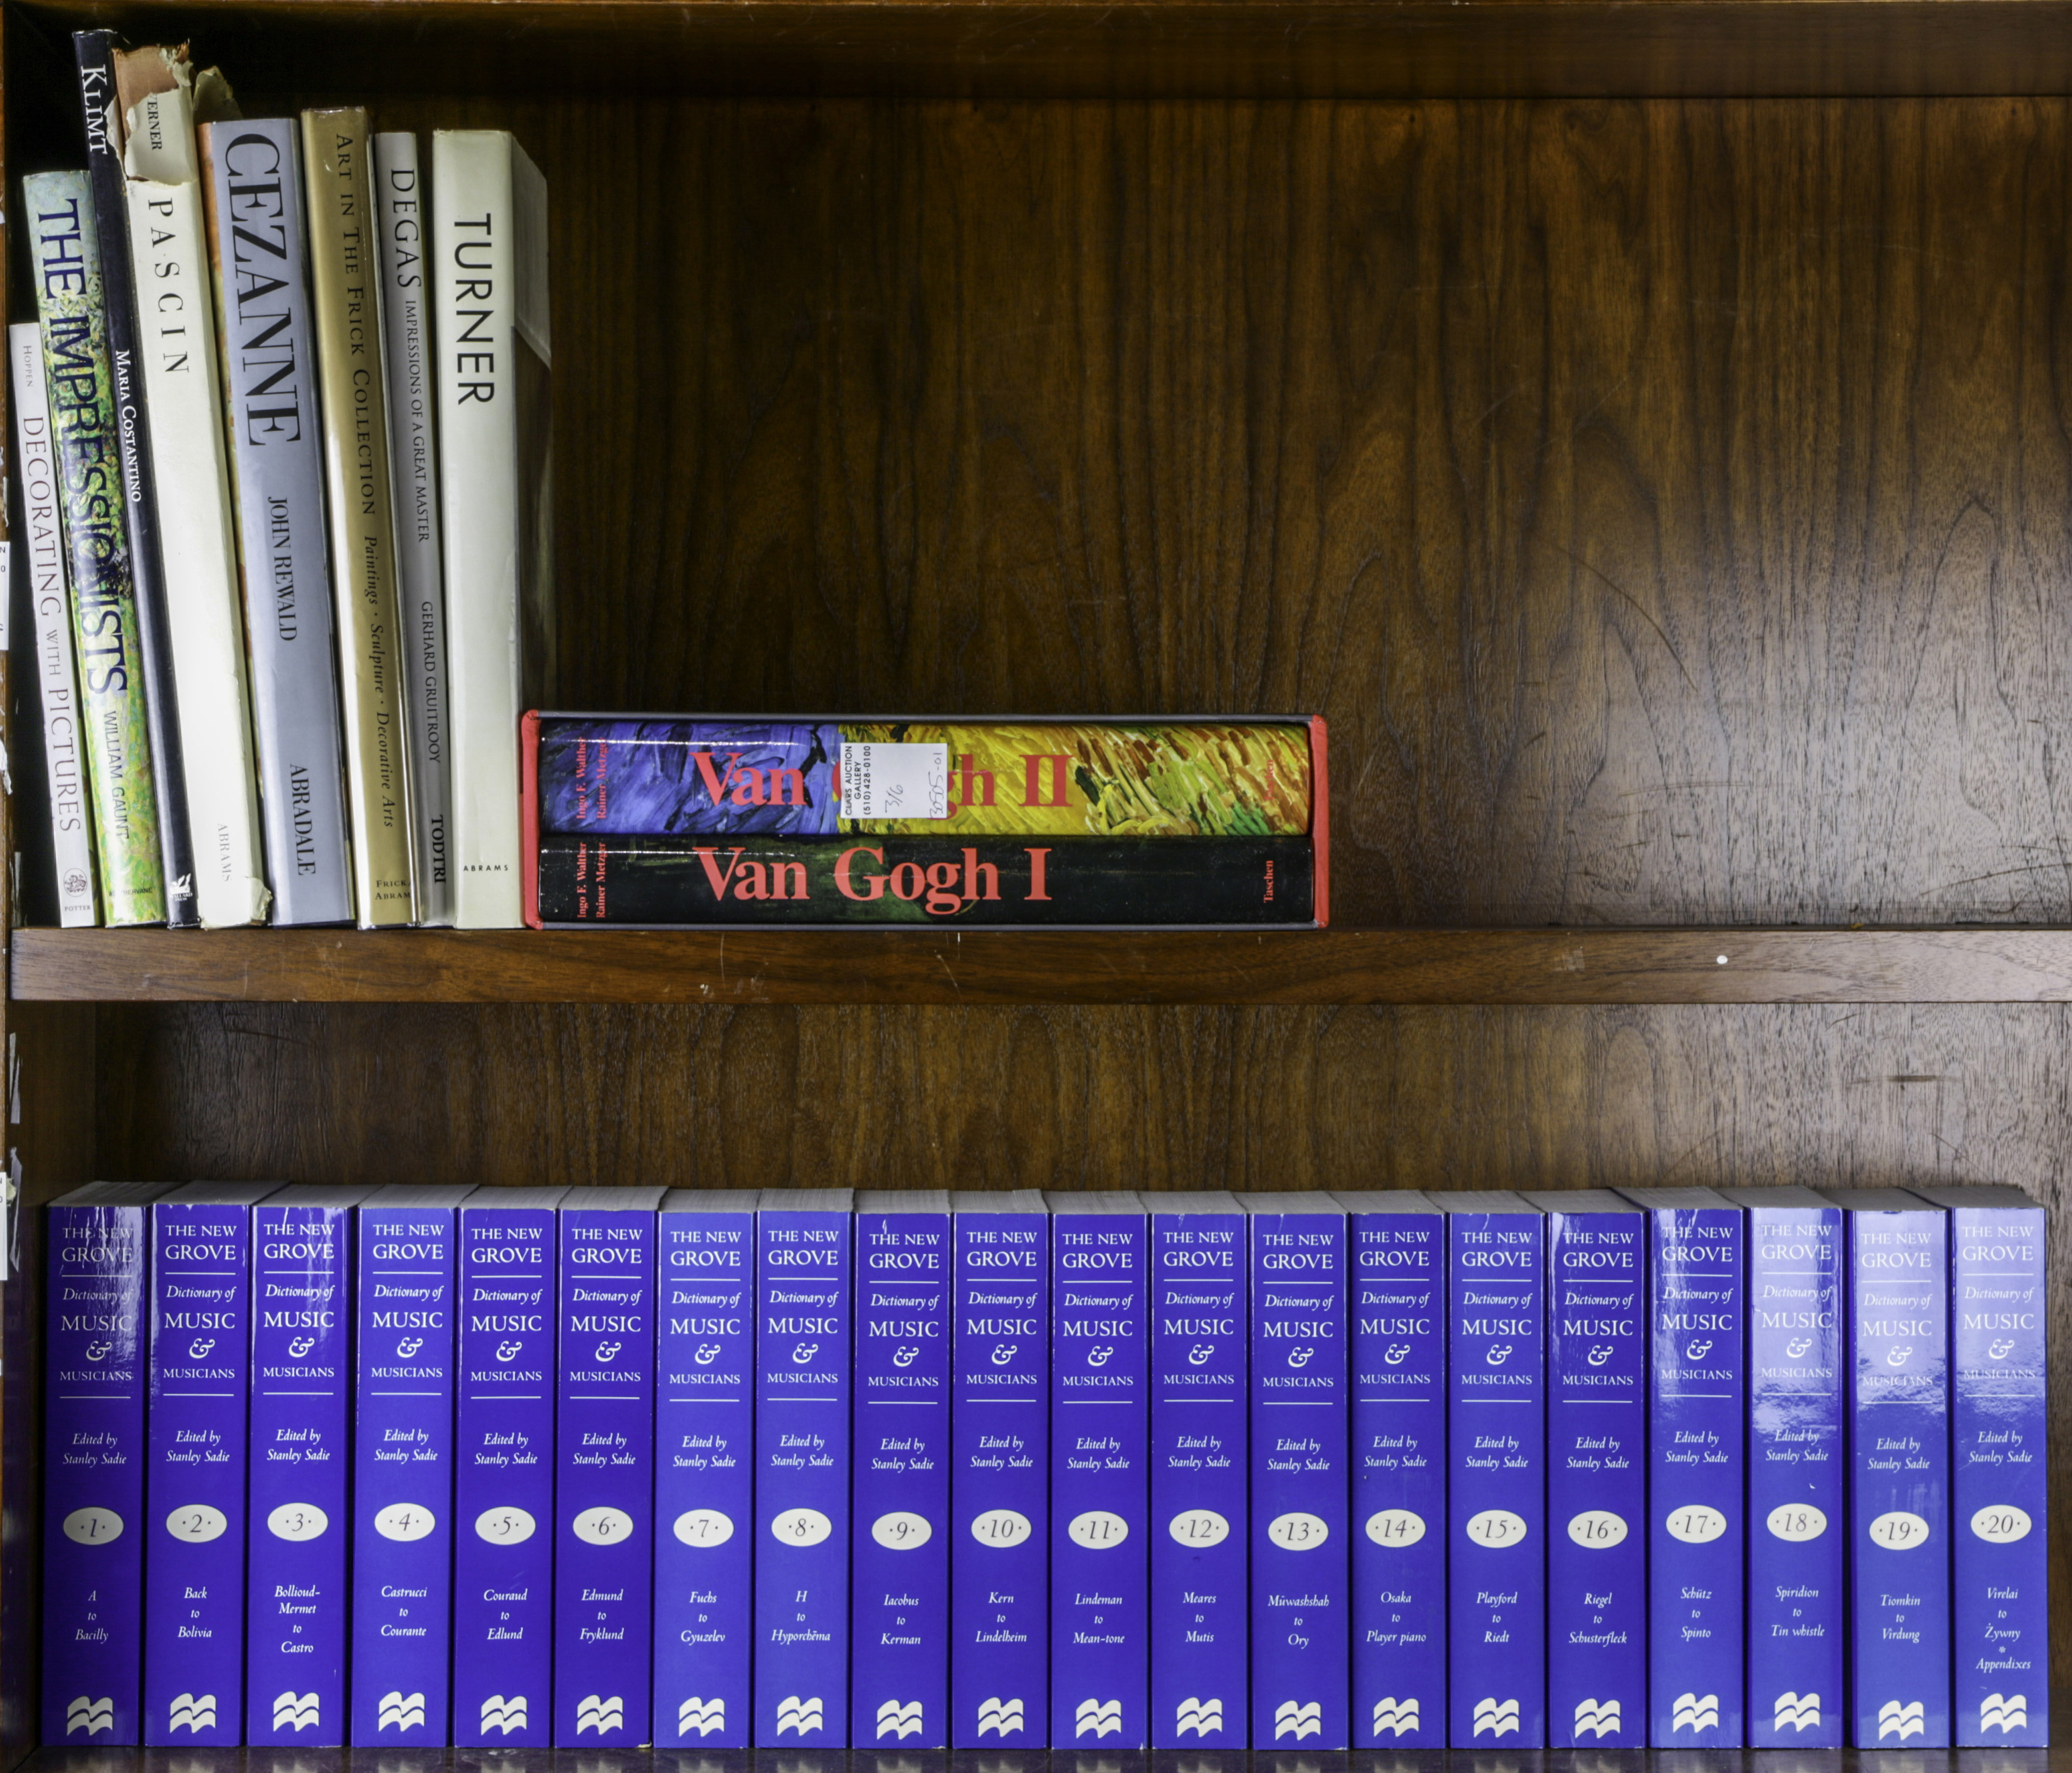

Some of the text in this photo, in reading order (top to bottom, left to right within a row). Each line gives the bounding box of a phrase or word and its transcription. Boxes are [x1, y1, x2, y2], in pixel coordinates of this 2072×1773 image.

[79, 64, 108, 155] KLIMT
[148, 198, 189, 372] PASCIN
[225, 133, 301, 446] CEZANNE
[454, 213, 495, 406] TURNER
[391, 168, 430, 543] DEGAS IMPRESSIONS OF A GREAT MASTER
[23, 345, 33, 387] HOPPEN
[116, 350, 141, 502] MARIA COSTANTINO
[38, 199, 127, 695] THE IMPRESSIONISTS
[336, 134, 396, 828] ART IN THE FRICK COLLECTION Paintings Sculpture Decorative Arts
[268, 497, 297, 641] JOHN REWALD
[23, 417, 80, 831] DECORATING WITH PICTURES
[422, 601, 440, 763] GERHARD GRUITROOY
[104, 711, 130, 839] WILLIAM GAUNT
[576, 736, 588, 819] Ingo F. Walther
[596, 737, 609, 819] Rainer Metzger
[690, 752, 808, 806] Van
[1019, 754, 1074, 807] II
[290, 763, 316, 875] ABRADALE
[217, 823, 232, 882] ABRAMS
[432, 815, 446, 884] TODTRI
[577, 842, 589, 919] Ingo F. Walther
[596, 843, 608, 919] Rainer Metzger
[692, 847, 1052, 915] Van Gogh I
[1264, 860, 1274, 904] Taschen
[375, 892, 411, 900] ABRAM
[165, 1225, 237, 1237] THE NEW
[1163, 1232, 1233, 1243] THE NEW
[165, 1245, 236, 1260] GROVE
[472, 1247, 542, 1263] GROVE
[768, 1250, 838, 1265] GROVE
[1163, 1251, 1233, 1267] GROVE
[167, 1285, 237, 1302] Dictionary of
[1165, 1292, 1235, 1309] Dictionary of
[165, 1313, 235, 1329] MUSIC
[472, 1315, 542, 1332] MUSIC
[768, 1317, 838, 1334] MUSIC
[1164, 1319, 1233, 1335] MUSIC
[189, 1338, 215, 1359] &
[1189, 1344, 1215, 1365] &
[163, 1368, 235, 1378] MUSICIANS
[1164, 1374, 1235, 1384] MUSICIANS
[176, 1430, 221, 1446] Edited by
[1177, 1436, 1222, 1452] Edited by
[1978, 1430, 2023, 1447] Edited by
[166, 1449, 230, 1465] Stanley Sadie
[1168, 1455, 1231, 1471] Stanley Sadie
[1969, 1450, 2033, 1466] Stanley Sadie
[88, 1590, 96, 1601] A
[184, 1586, 207, 1599] Back
[275, 1585, 320, 1597] Bollioud-
[381, 1585, 427, 1597] Castrucci
[483, 1588, 528, 1601] Couraud
[581, 1588, 624, 1601] Edmund
[690, 1591, 717, 1603] Fuchs
[796, 1591, 807, 1602] H
[989, 1592, 1014, 1604] Kern
[1075, 1592, 1122, 1605] Lindeman
[1183, 1592, 1216, 1604] Meares
[1381, 1591, 1412, 1603] Osaka
[1680, 1587, 1712, 1599] Schütz
[1775, 1585, 1819, 1600] Spiridion
[1988, 1587, 2018, 1599] Virelai
[884, 1593, 919, 1606] Iacobus
[1268, 1594, 1330, 1606] Mūwashshah
[1476, 1591, 1518, 1608] Playford
[1584, 1592, 1612, 1608] Riegel
[1881, 1593, 1920, 1606] Tiomkin
[190, 1609, 200, 1618] to
[279, 1602, 316, 1614] Mermet
[501, 1612, 509, 1620] to
[1692, 1609, 1701, 1618] to
[1998, 1610, 2007, 1618] to
[796, 1613, 806, 1621] to
[1094, 1615, 1103, 1624] to
[1392, 1614, 1401, 1622] to
[76, 1628, 108, 1644] Bacilly
[178, 1625, 212, 1638] Bolivia
[380, 1625, 427, 1636] Courante
[487, 1627, 523, 1640] Edlund
[580, 1627, 624, 1643] Fryklund
[680, 1629, 726, 1646] Gyuzelev
[771, 1628, 830, 1645] Hyporchēma
[976, 1629, 1027, 1642] Lindelheim
[1073, 1632, 1125, 1643] Mean-tone
[1185, 1631, 1214, 1642] Mutis
[1366, 1629, 1427, 1646] Player piano
[1484, 1631, 1509, 1642] Riedt
[1681, 1626, 1711, 1640] Spinto
[1772, 1624, 1825, 1636] Tin whistle
[1883, 1627, 1920, 1643] Virdung
[1985, 1622, 2021, 1642] Żywny
[281, 1641, 314, 1653] Castro
[881, 1633, 921, 1645] Kerman
[1288, 1634, 1309, 1649] Ory
[1569, 1631, 1627, 1647] Schusterfleck
[1976, 1656, 2031, 1673] Appendixes
